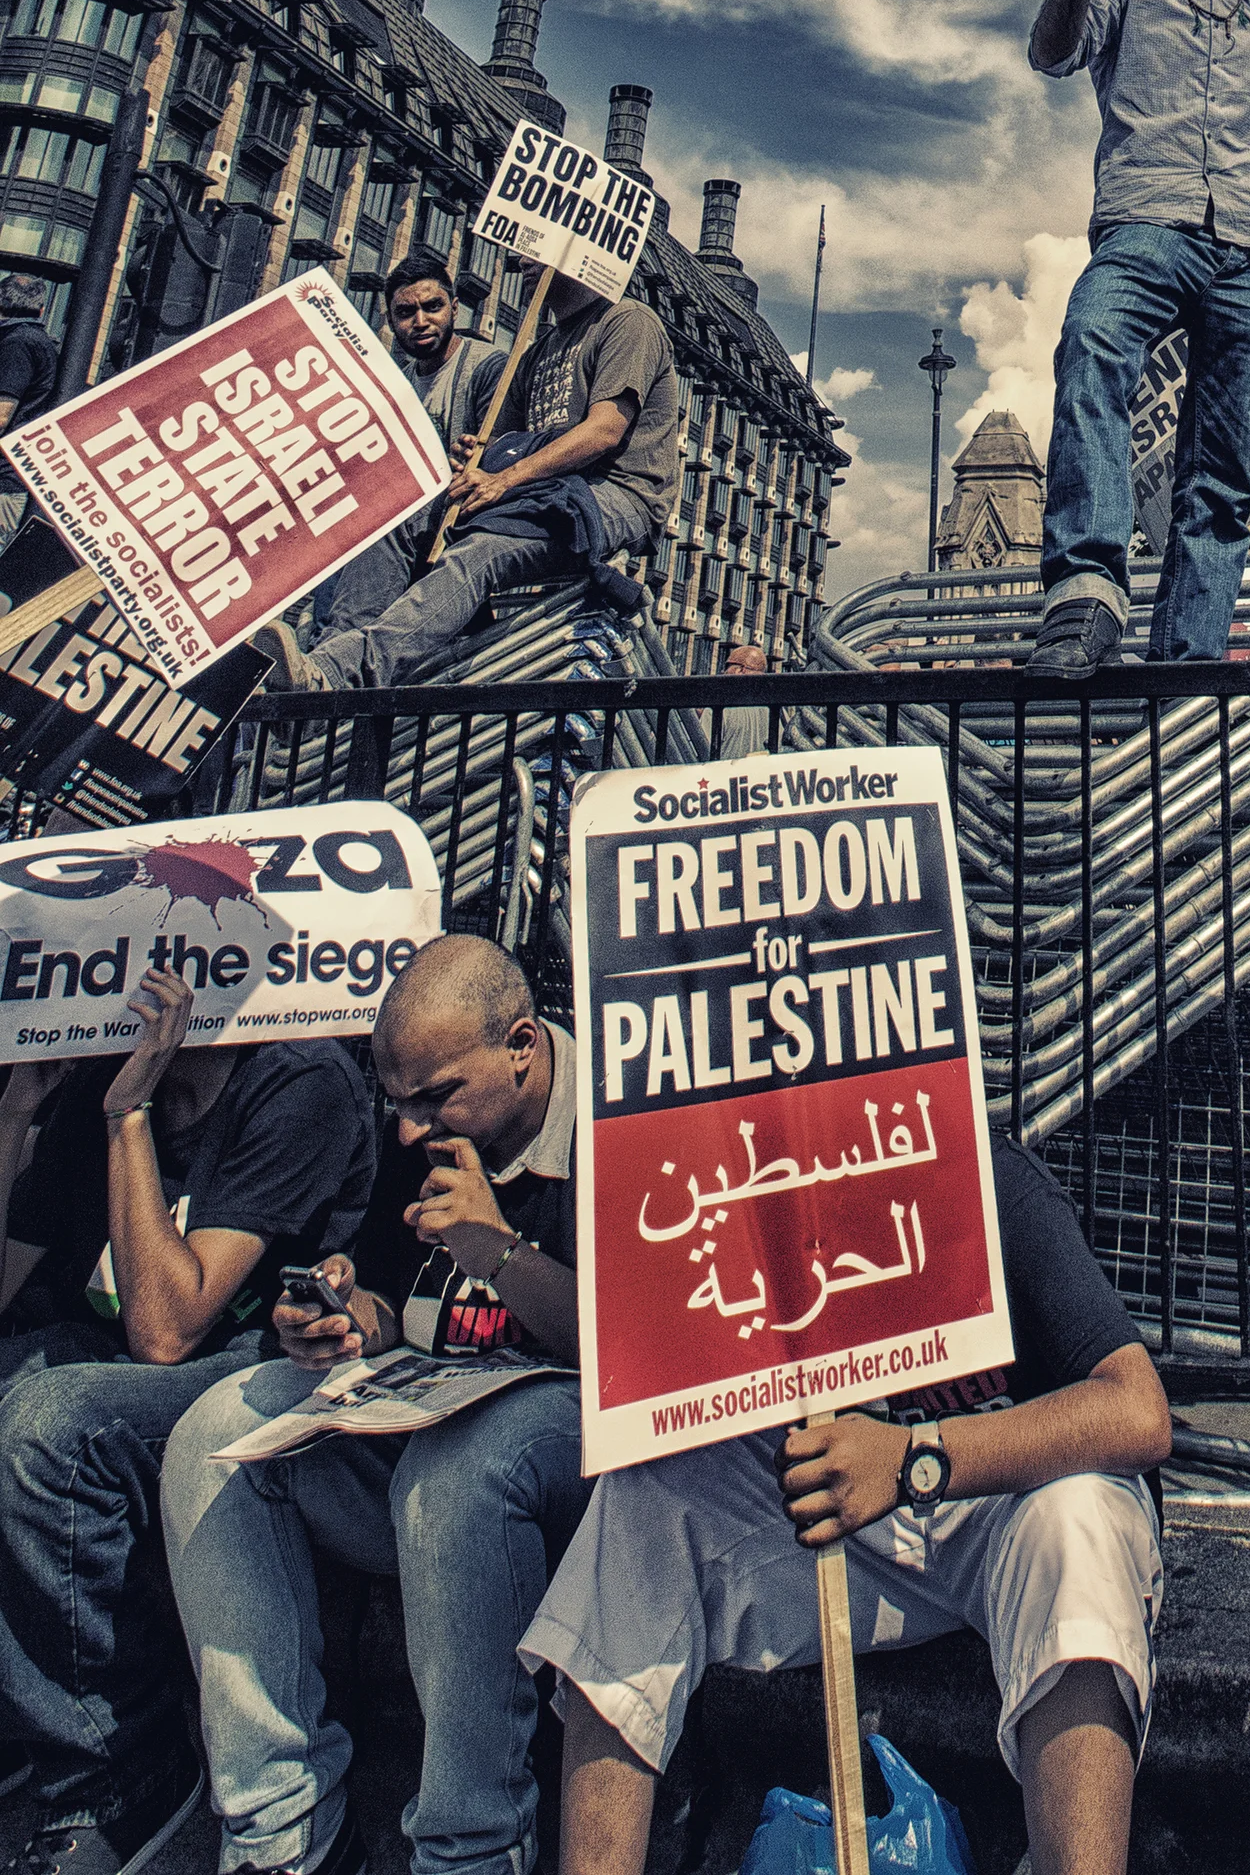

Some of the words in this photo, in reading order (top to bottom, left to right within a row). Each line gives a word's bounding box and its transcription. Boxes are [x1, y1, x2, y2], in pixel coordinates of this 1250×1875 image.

[481, 210, 520, 247] FOA
[497, 162, 640, 264] BOMBING
[514, 127, 598, 189] STOP
[601, 169, 652, 228] THE
[307, 295, 345, 338] Party
[320, 295, 369, 357] Socialist
[200, 348, 359, 538] ISRAELI
[275, 345, 388, 463] STOP
[80, 406, 252, 621] TERROR
[159, 401, 296, 558] STATE
[10, 441, 184, 680] www.socialistparty.org.uk
[22, 424, 73, 481] join
[69, 481, 108, 528] the
[106, 531, 212, 668] socialists!
[617, 816, 921, 938] FREEDOM
[1, 935, 130, 1001] End
[148, 933, 249, 989] the
[266, 929, 419, 997] siege
[753, 927, 802, 973] for
[16, 1027, 61, 1047] Stop
[66, 1023, 97, 1041] the
[104, 1022, 140, 1038] War
[604, 955, 955, 1103] PALESTINE
[637, 1090, 938, 1243] لفلسطين
[687, 1199, 925, 1339] الحرية
[652, 1332, 949, 1438] www.socialistworker.co.uk
